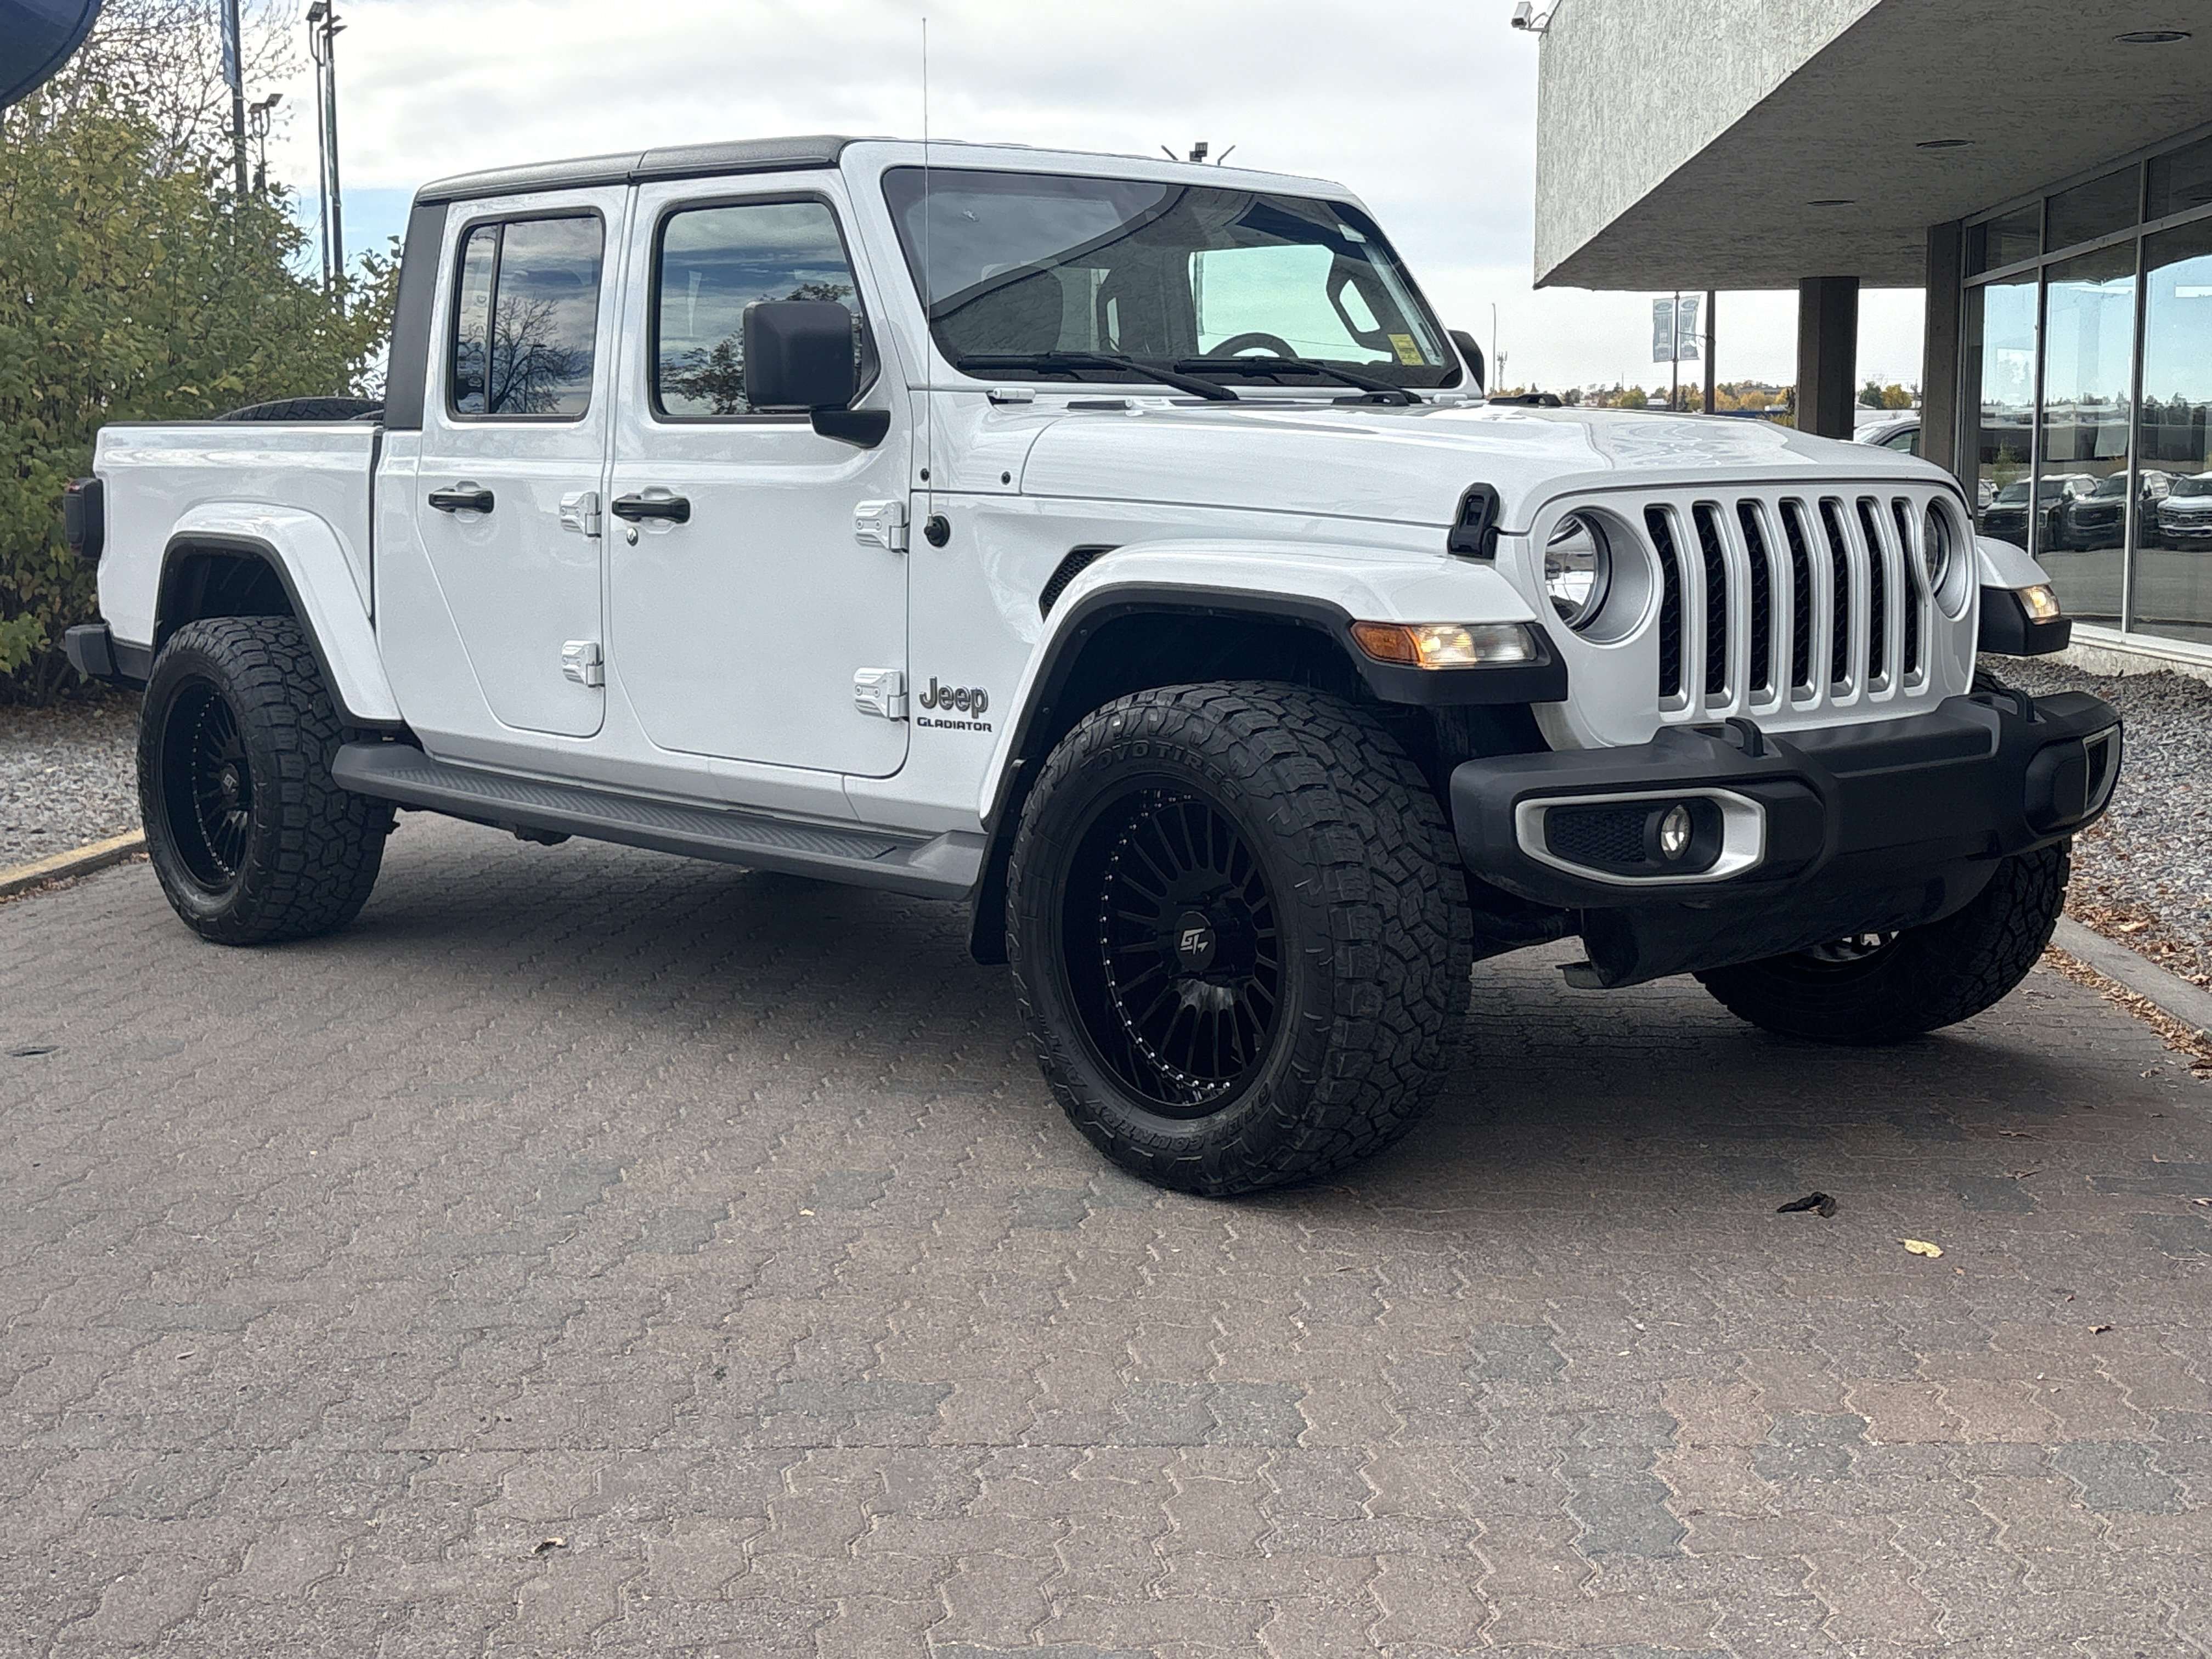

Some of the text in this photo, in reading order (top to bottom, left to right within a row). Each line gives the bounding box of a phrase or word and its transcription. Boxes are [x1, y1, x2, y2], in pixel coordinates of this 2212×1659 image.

[919, 676, 989, 719] Jeep
[916, 716, 992, 732] GLADIATOR
[1155, 740, 1243, 800] TIRES
